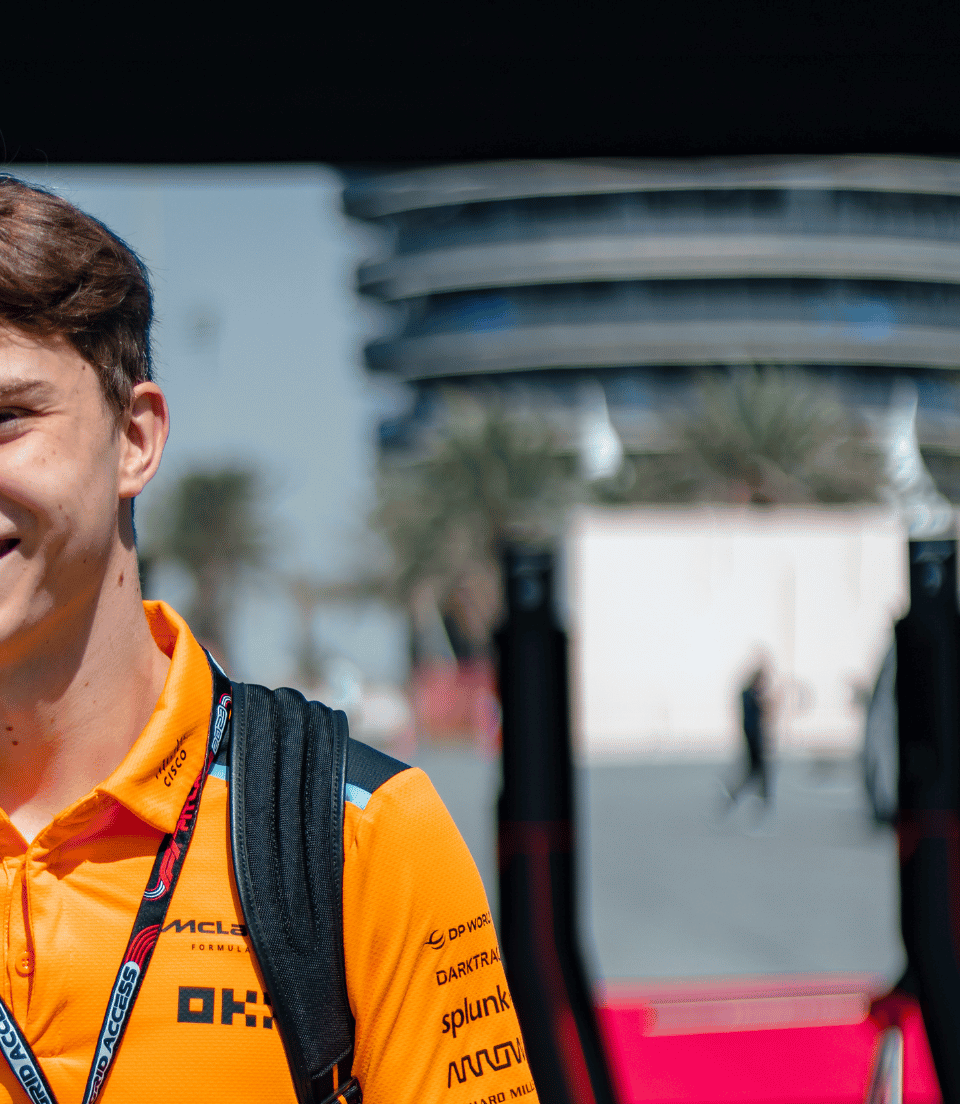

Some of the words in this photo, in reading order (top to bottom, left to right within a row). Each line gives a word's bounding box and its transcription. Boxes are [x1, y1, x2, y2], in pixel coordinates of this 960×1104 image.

[163, 749, 187, 788] CISCO
[161, 919, 249, 936] McLa
[448, 924, 466, 941] DP
[467, 911, 491, 930] WORL
[191, 943, 251, 953] FORMULA
[103, 966, 138, 1053] ACCESS
